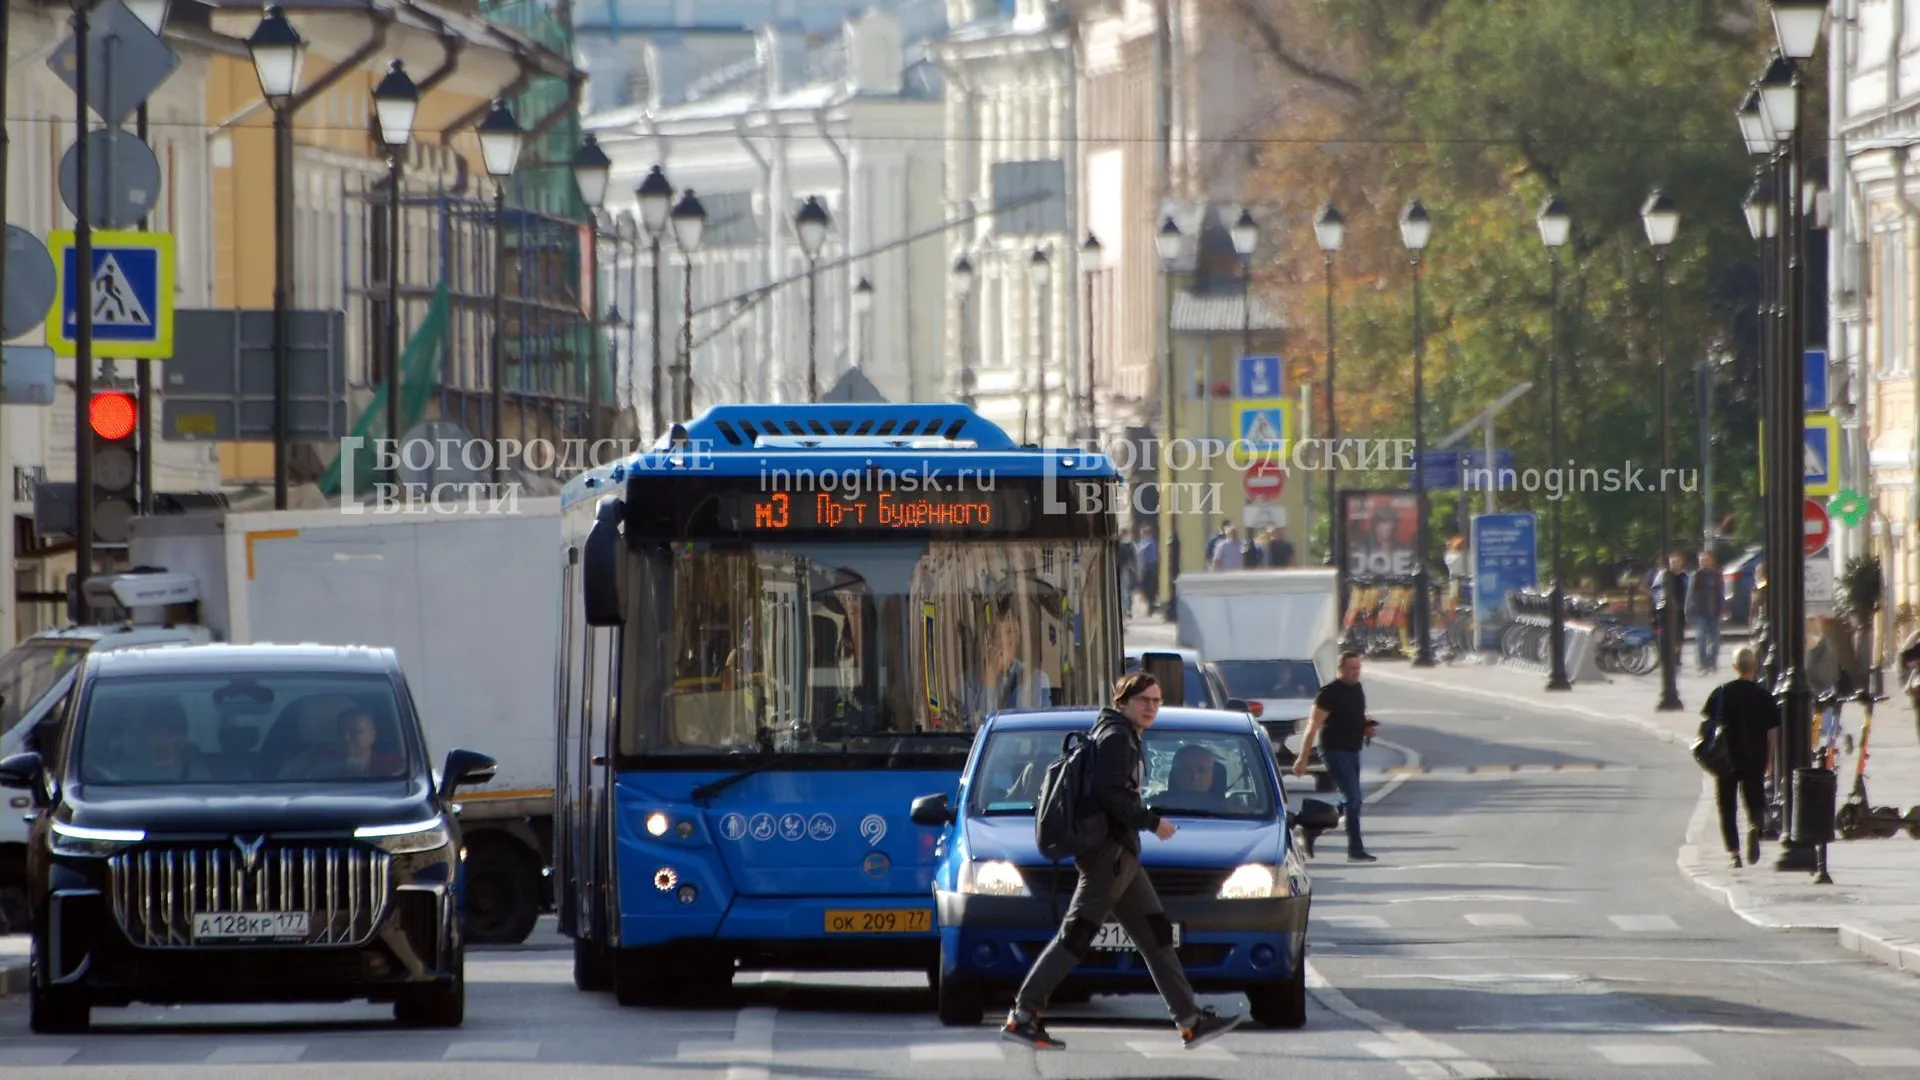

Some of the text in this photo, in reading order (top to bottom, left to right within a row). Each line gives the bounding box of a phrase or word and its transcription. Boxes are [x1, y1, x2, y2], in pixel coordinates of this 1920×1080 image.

[817, 493, 867, 527] Пр-т
[879, 493, 991, 528] Будённого
[277, 914, 304, 928] 177
[863, 913, 896, 930] 209
[907, 912, 925, 925] 77
